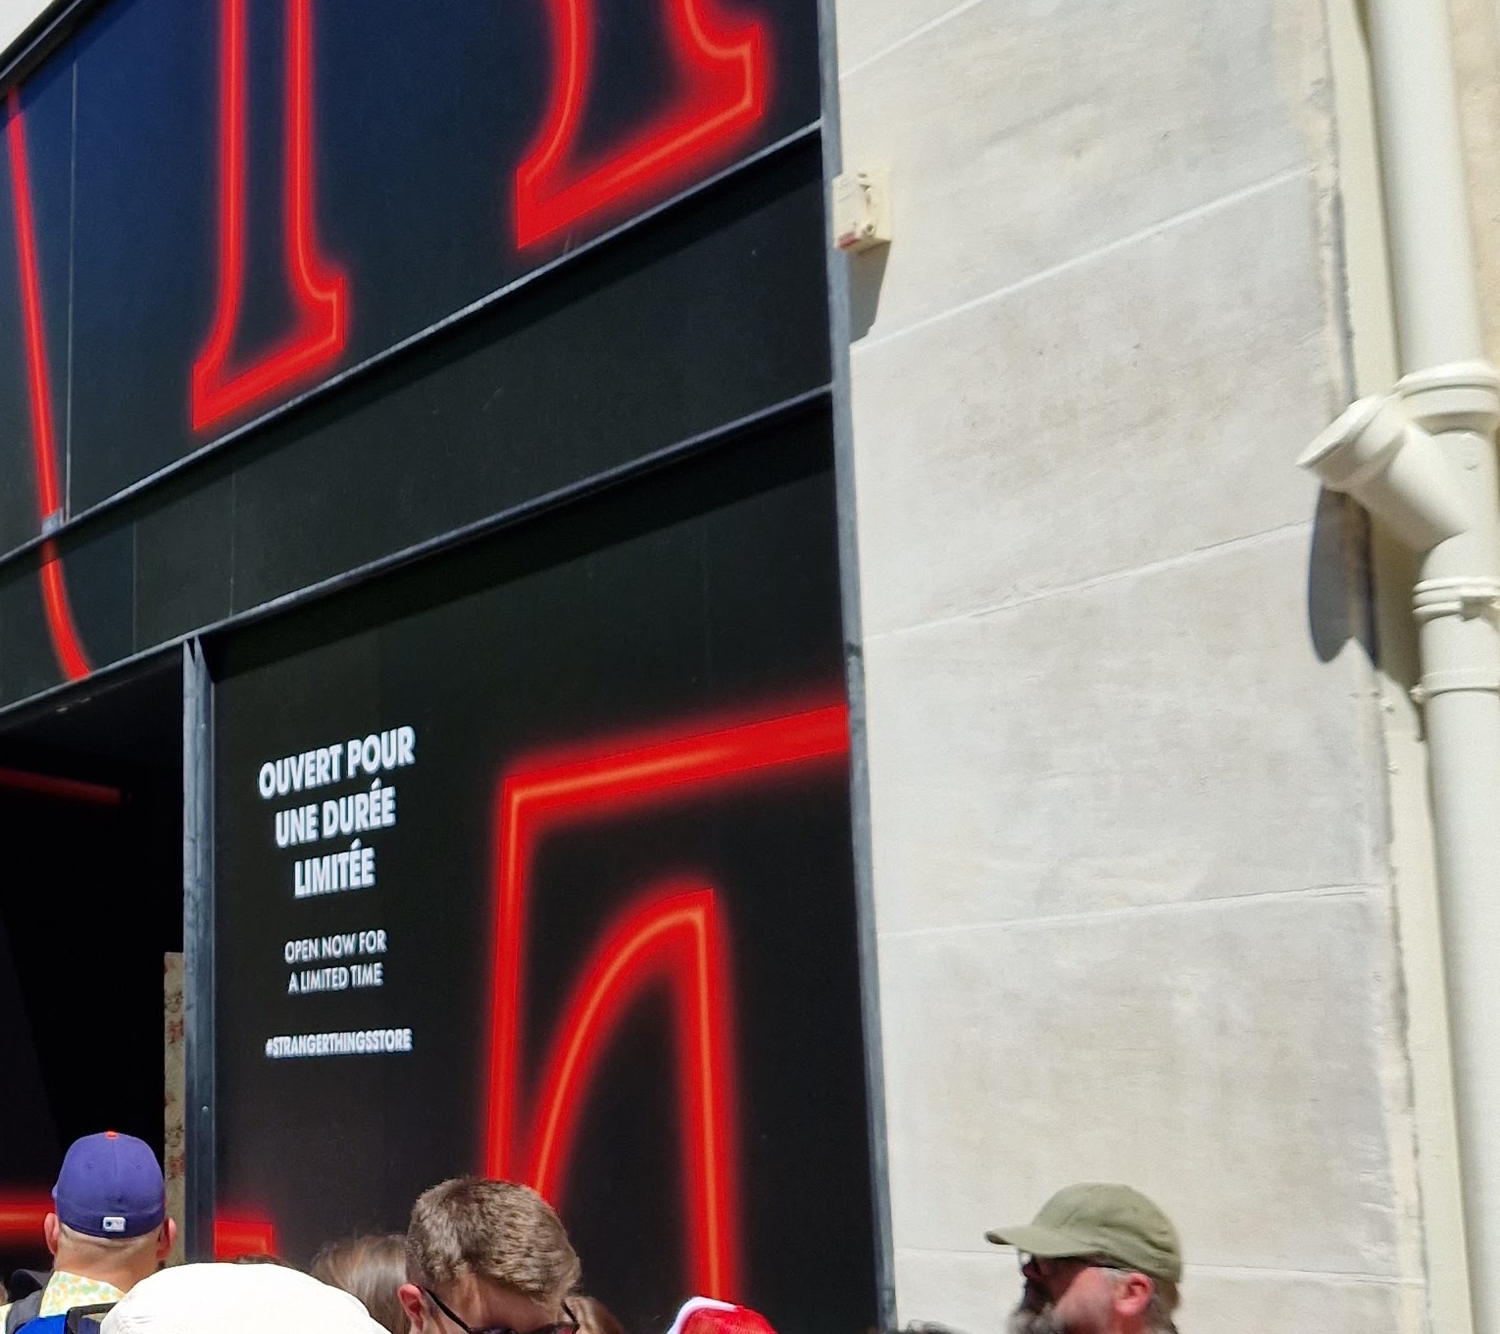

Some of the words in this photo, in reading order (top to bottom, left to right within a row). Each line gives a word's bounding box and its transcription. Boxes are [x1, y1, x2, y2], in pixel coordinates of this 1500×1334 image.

[258, 744, 344, 799] OUVERT
[347, 725, 416, 778] POUR
[275, 803, 319, 848] UNE
[322, 777, 397, 838] DURÉE
[294, 838, 376, 898] LIMITÉE
[284, 936, 320, 964] OPEN
[322, 933, 357, 959] NOW
[359, 929, 388, 954] FOR
[287, 972, 300, 995] A
[300, 966, 349, 994] LIMITED
[350, 962, 384, 989] TIME
[265, 1028, 413, 1058] #STRANGERTHINGSSTORE
